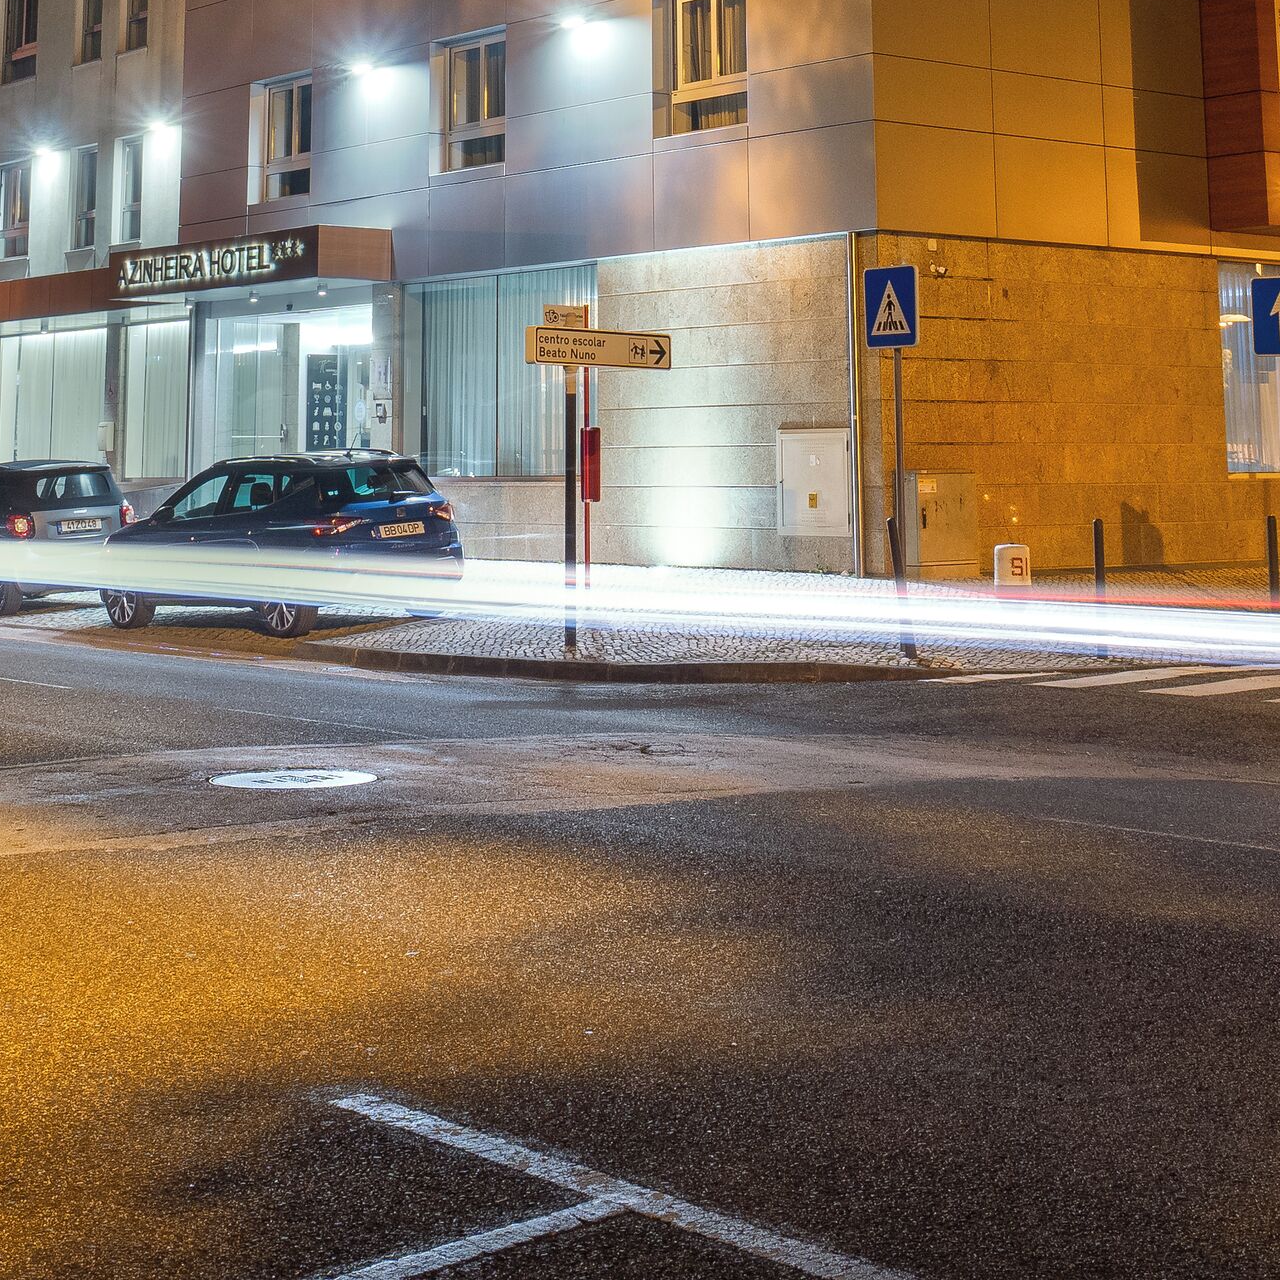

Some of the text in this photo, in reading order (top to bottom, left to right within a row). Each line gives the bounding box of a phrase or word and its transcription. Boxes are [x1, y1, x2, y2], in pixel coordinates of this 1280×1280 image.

[118, 245, 271, 286] AZINHEIRA HOTEL
[539, 334, 606, 348] centro escolar
[539, 347, 596, 361] Beato Nuno
